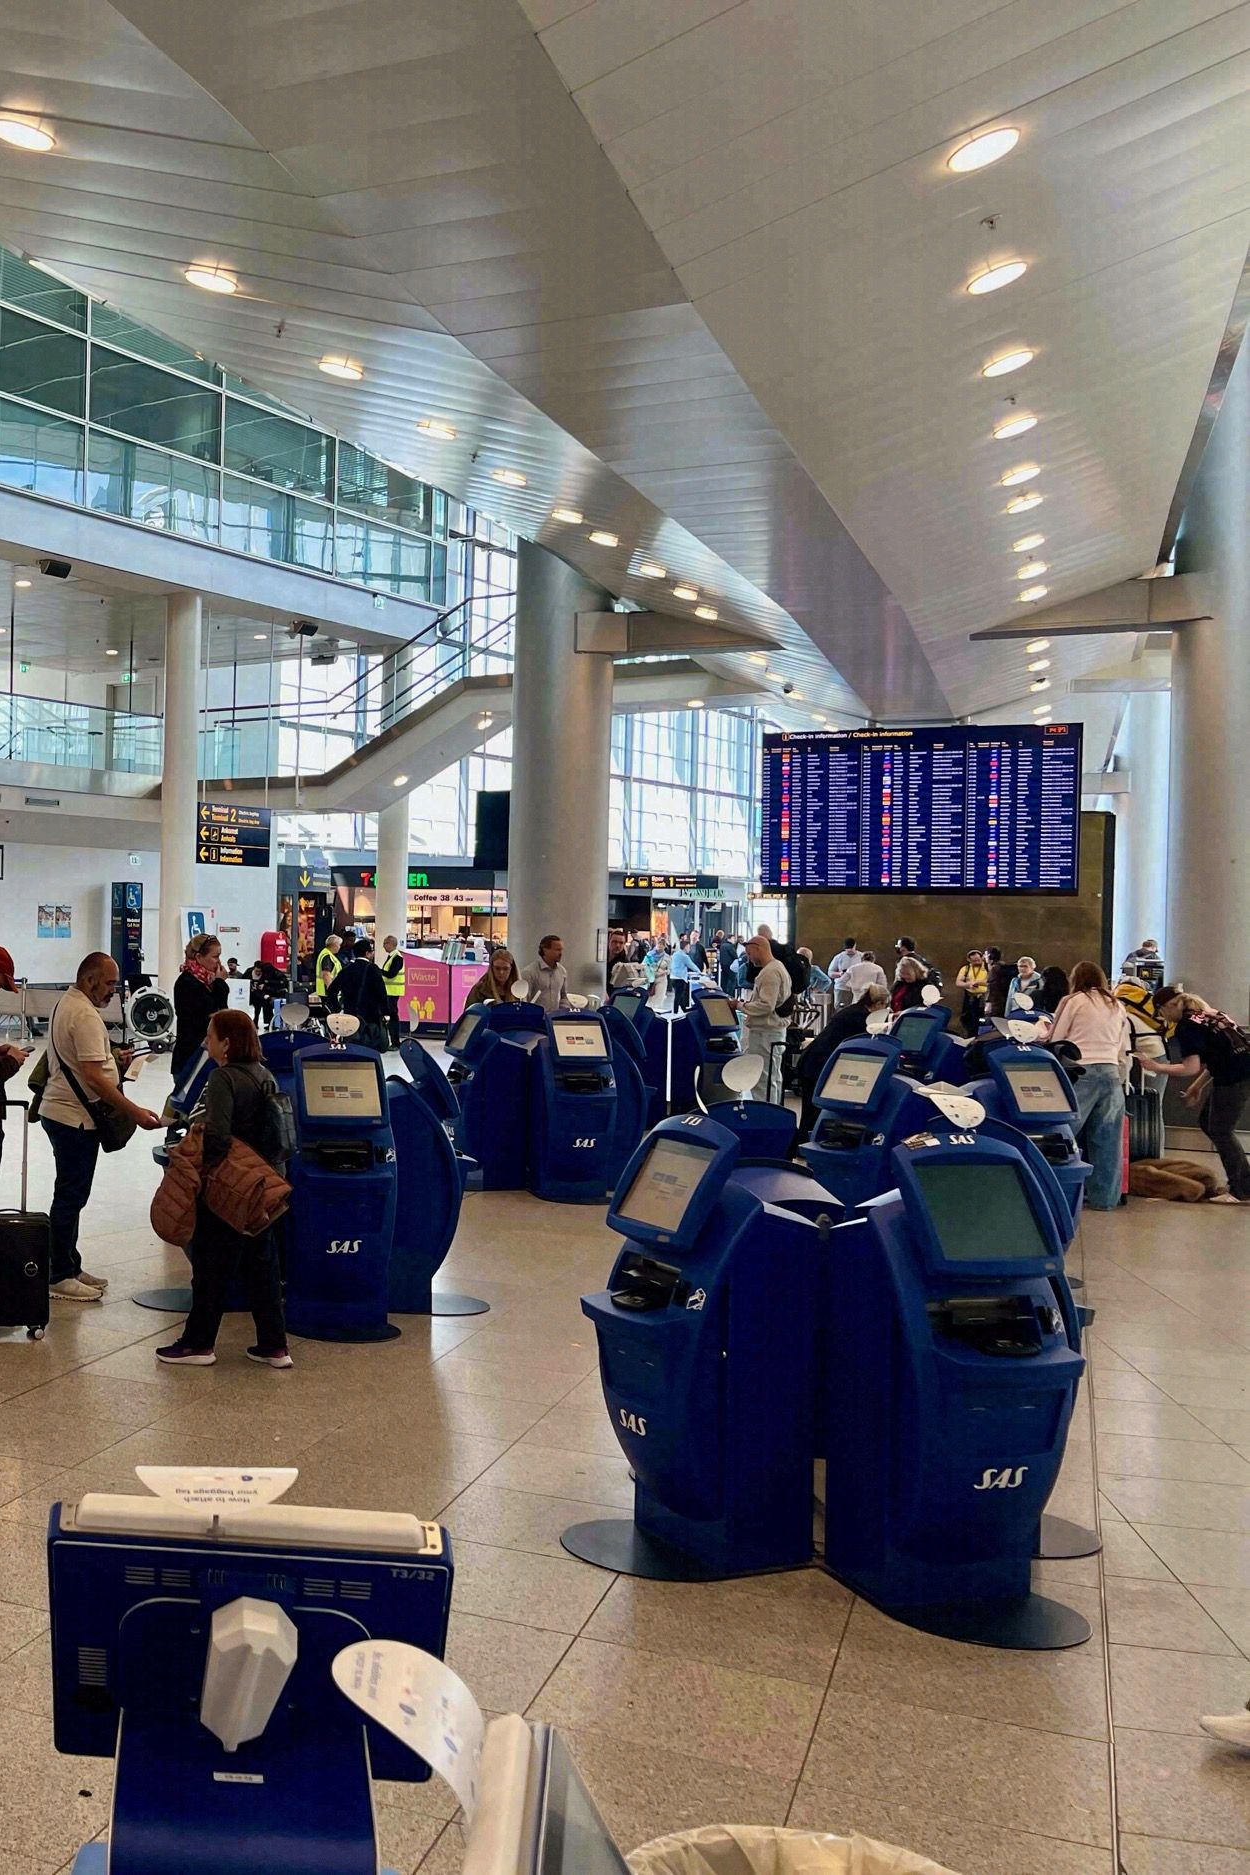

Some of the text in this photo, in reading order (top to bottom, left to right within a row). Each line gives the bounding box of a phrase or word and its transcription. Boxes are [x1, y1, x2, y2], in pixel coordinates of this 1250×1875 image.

[211, 814, 229, 822] Terminal
[212, 805, 237, 823] Terminal 2
[220, 847, 243, 855] Information
[219, 855, 243, 863] Information
[669, 877, 674, 887] 1
[411, 972, 436, 982] Waste
[573, 1138, 597, 1148] SAS
[950, 1135, 975, 1145] SAS
[326, 1240, 363, 1254] SAS
[619, 1409, 647, 1436] SAS
[973, 1466, 1029, 1490] SAS
